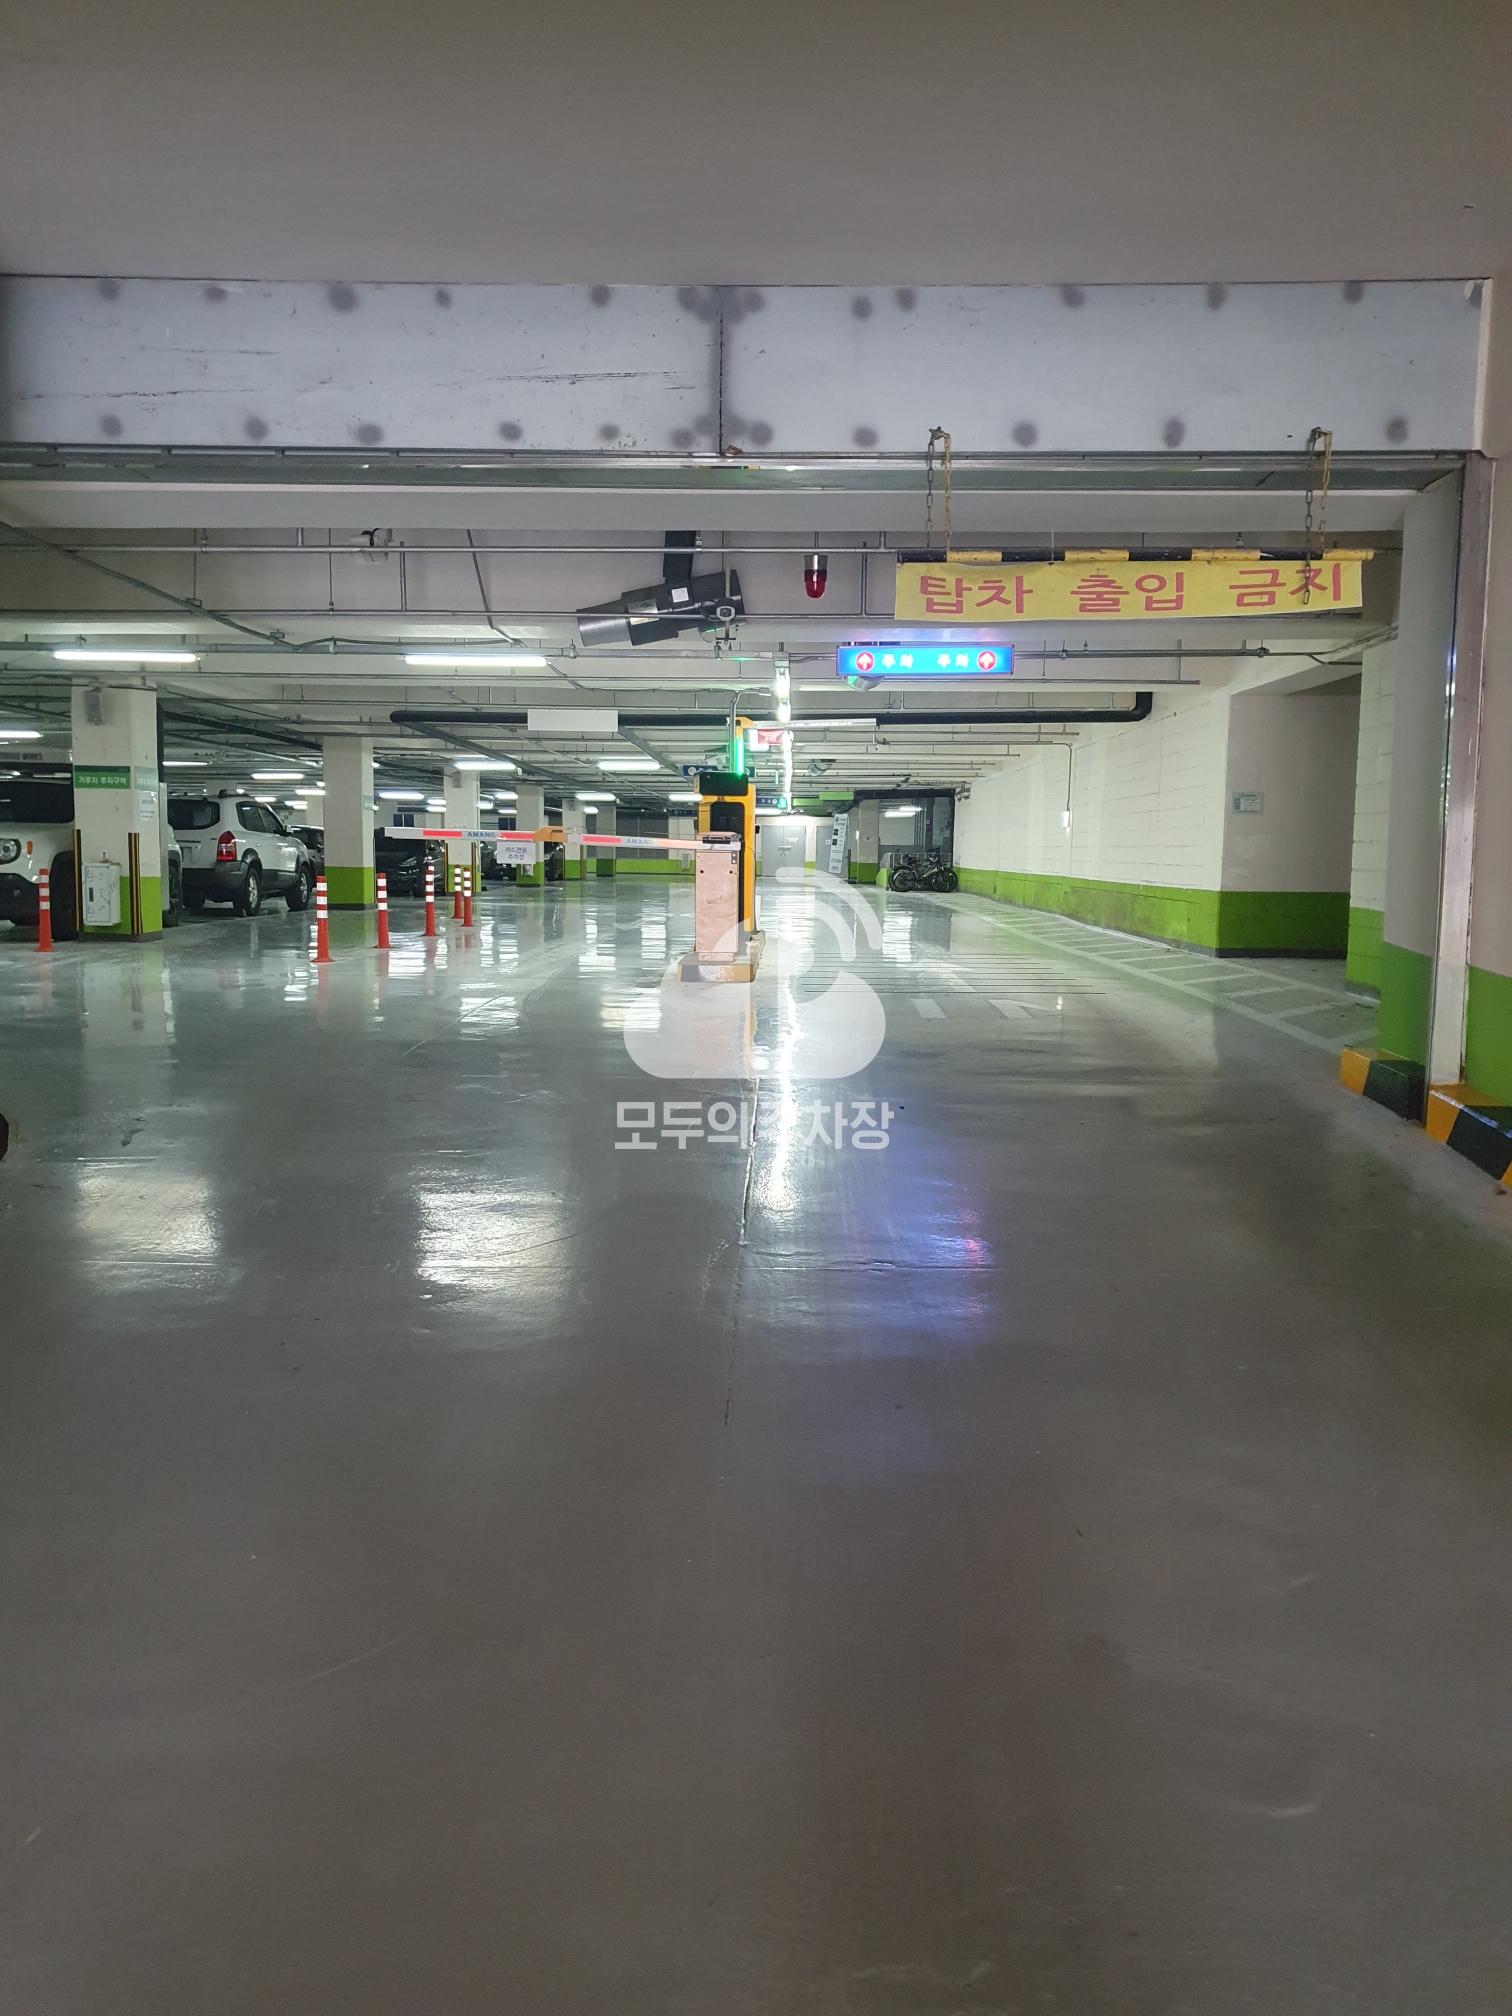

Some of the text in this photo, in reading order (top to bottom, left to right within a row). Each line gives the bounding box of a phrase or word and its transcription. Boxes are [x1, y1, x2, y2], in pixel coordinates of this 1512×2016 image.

[919, 562, 1343, 615] 탑차 출입 금지
